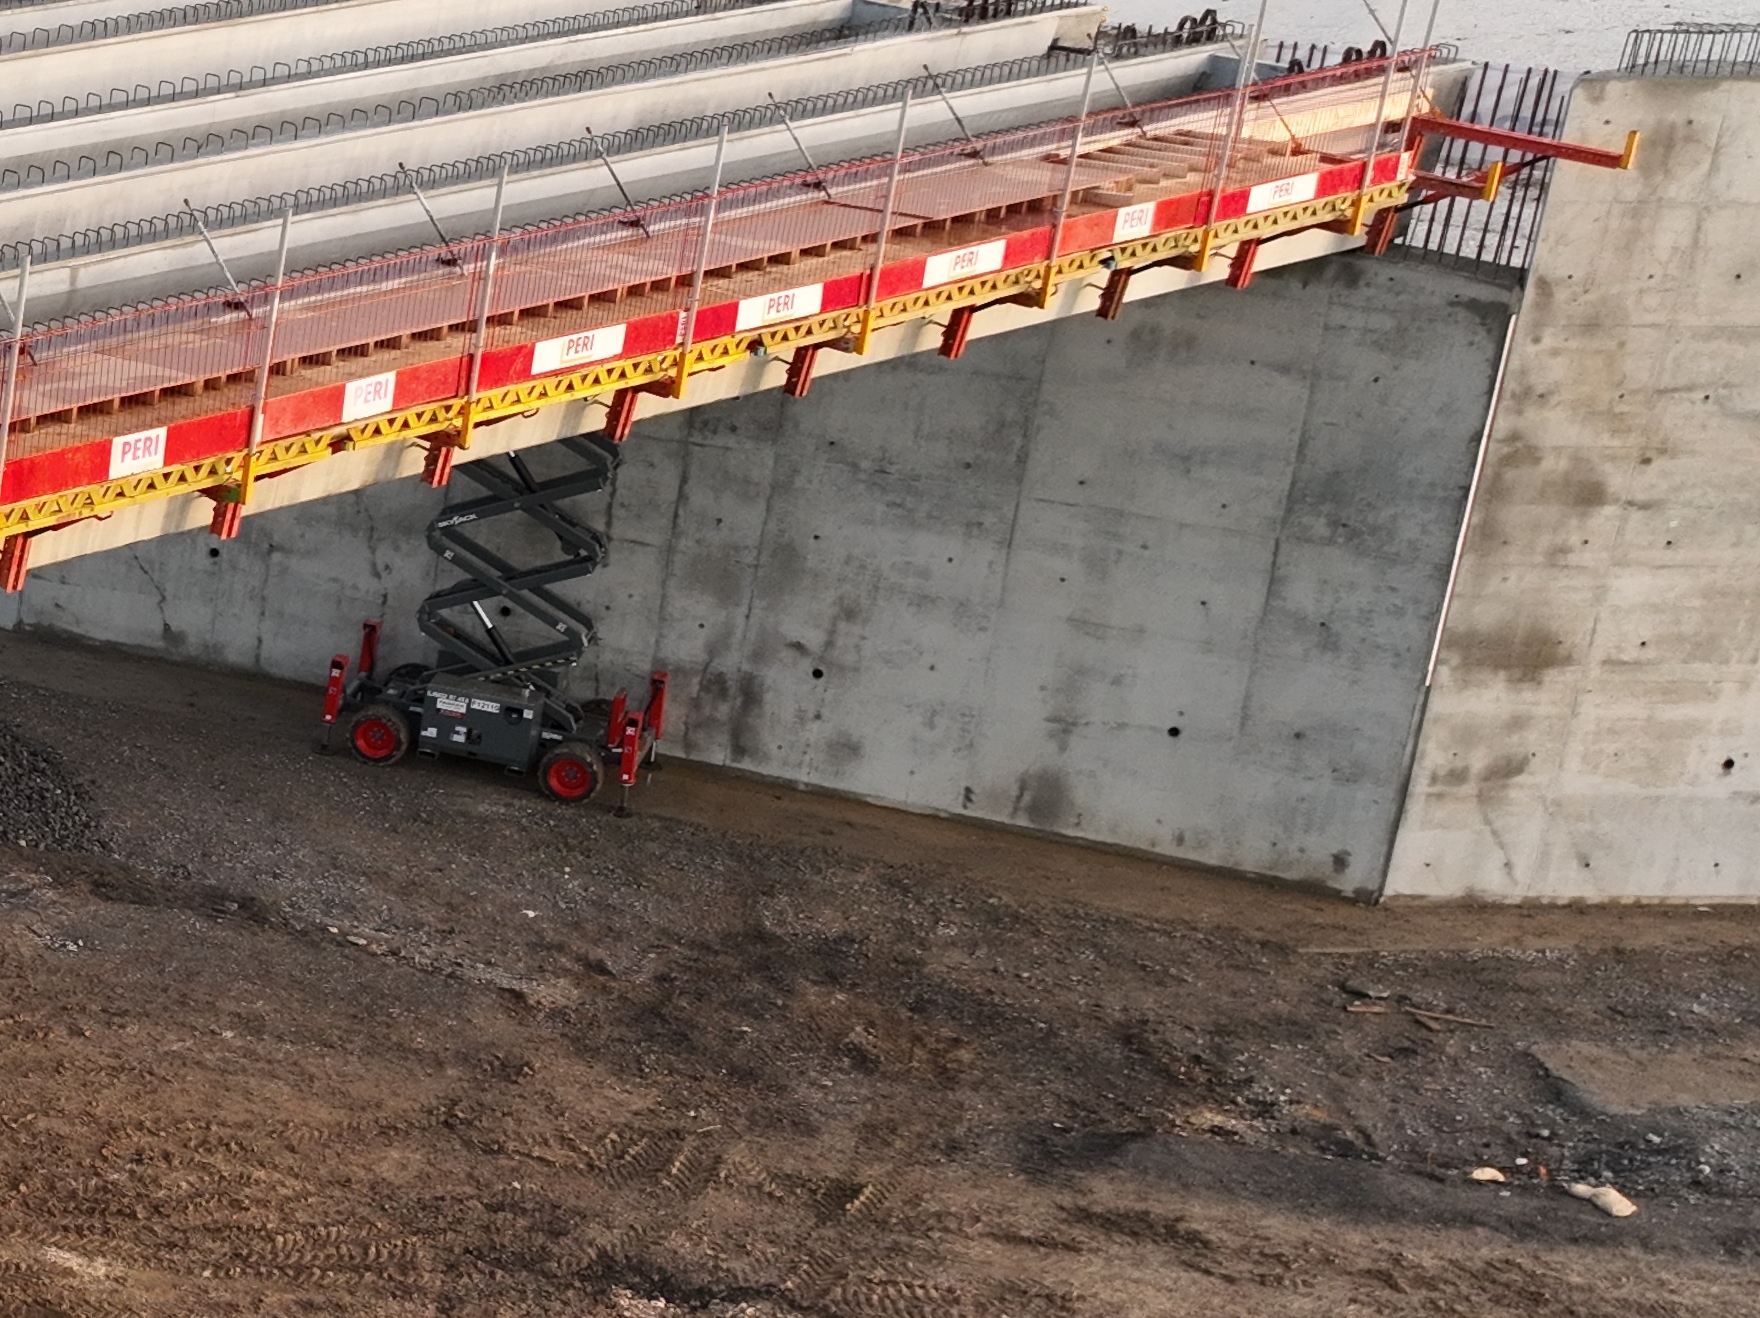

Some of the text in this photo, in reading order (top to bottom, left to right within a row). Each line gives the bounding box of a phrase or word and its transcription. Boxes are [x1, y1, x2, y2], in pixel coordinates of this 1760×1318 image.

[1121, 207, 1149, 231] PERI
[953, 250, 980, 272] PERI
[766, 293, 796, 316] PERI
[566, 334, 595, 357] PERI
[353, 379, 389, 407] PERI
[120, 434, 160, 463] PERI
